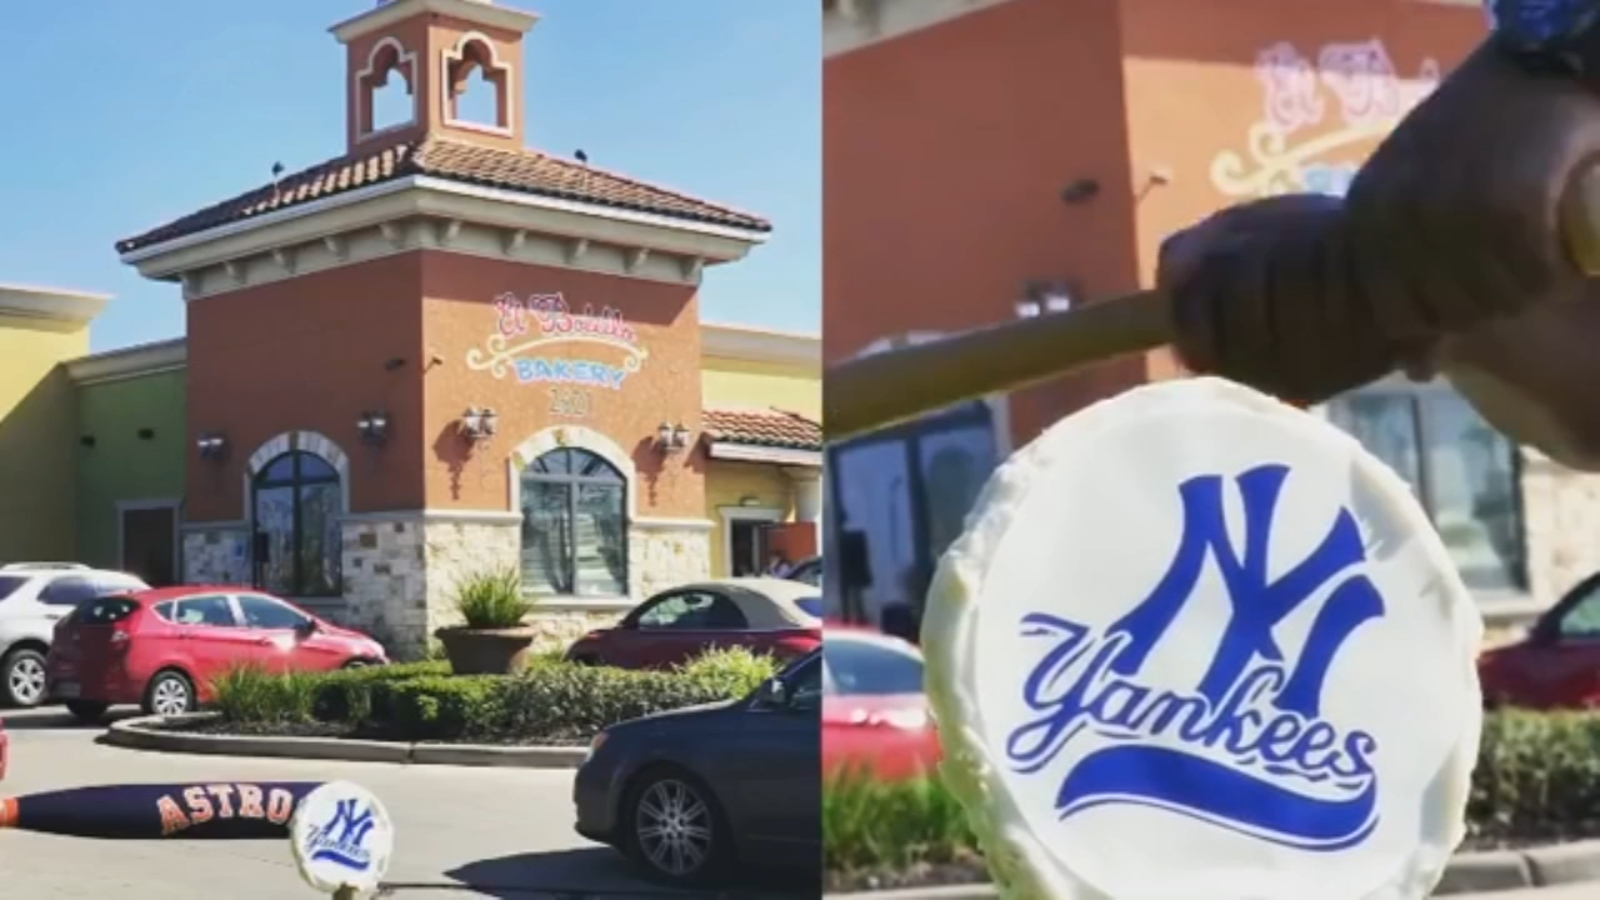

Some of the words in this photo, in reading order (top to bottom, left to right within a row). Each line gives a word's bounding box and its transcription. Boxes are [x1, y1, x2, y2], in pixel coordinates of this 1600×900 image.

[494, 292, 527, 339] El
[514, 357, 626, 390] BAKERY
[1104, 464, 1385, 721] NY
[1006, 612, 1378, 779] Yankees
[156, 784, 293, 835] ASTRO
[326, 798, 374, 845] NY
